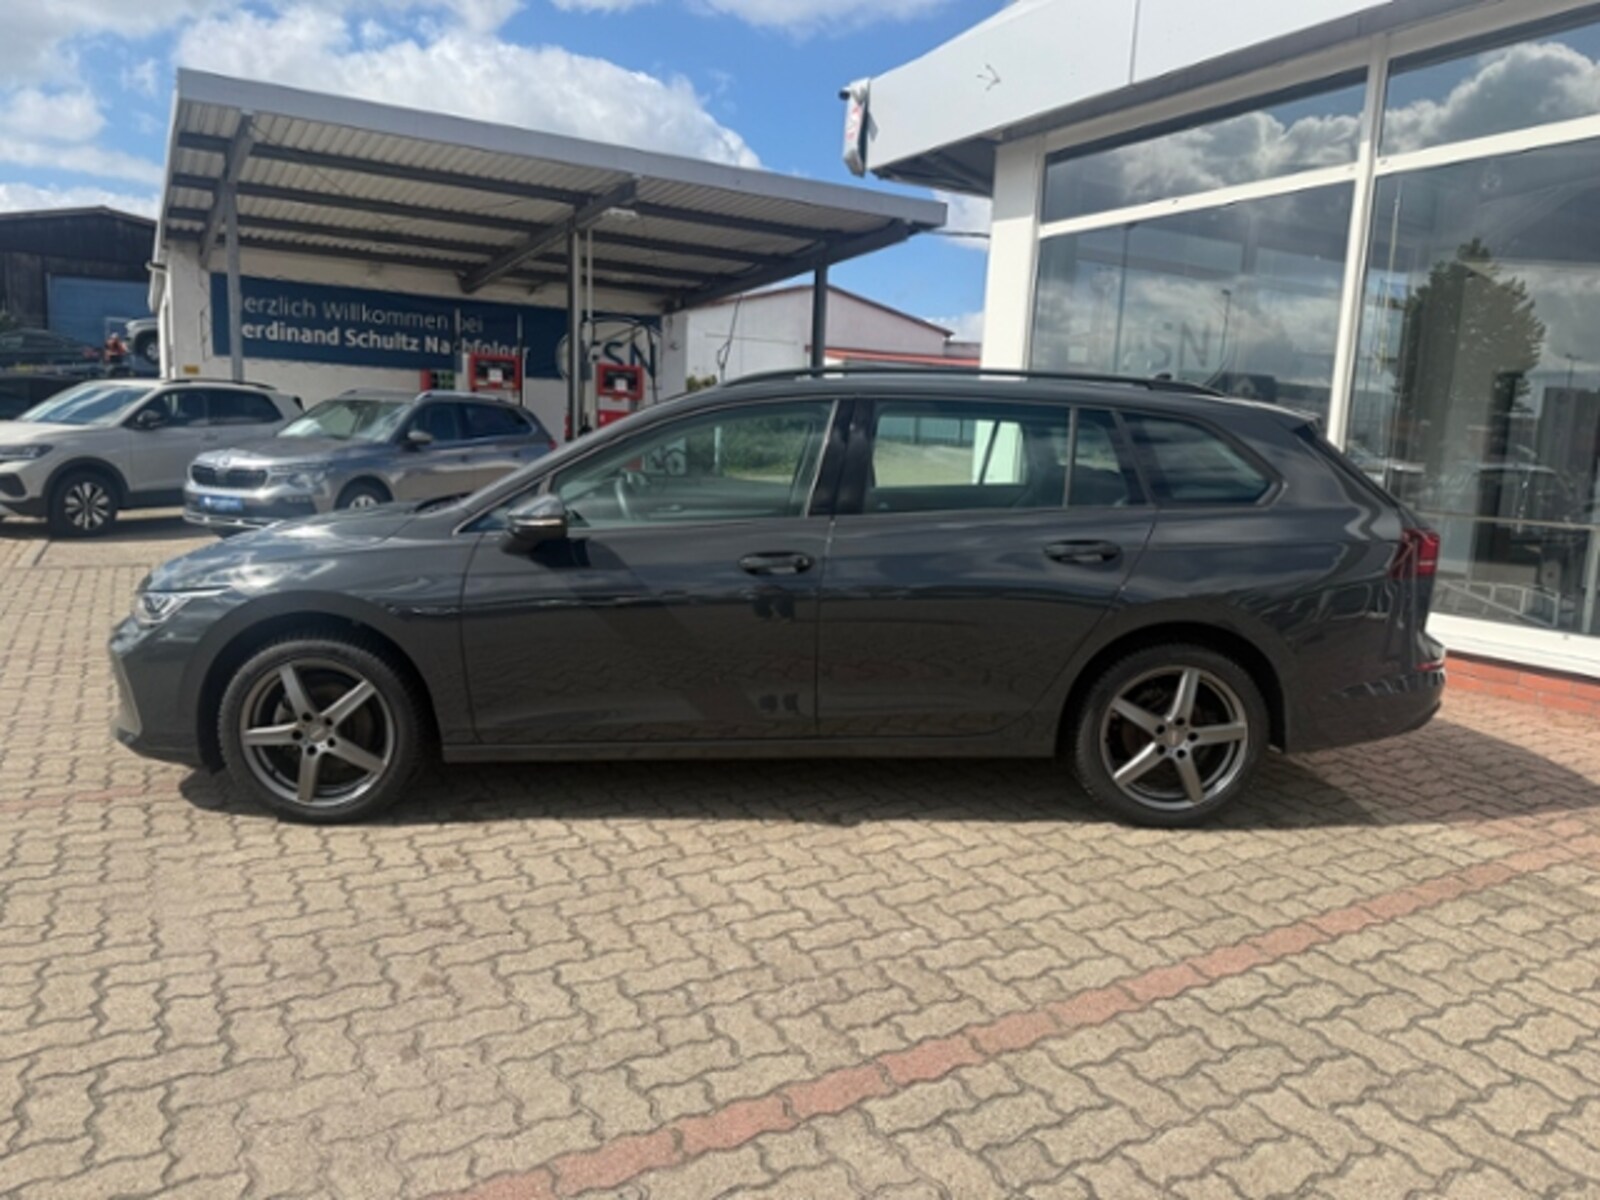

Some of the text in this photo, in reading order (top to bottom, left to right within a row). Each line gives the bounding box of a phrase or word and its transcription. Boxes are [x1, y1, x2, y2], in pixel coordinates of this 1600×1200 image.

[241, 296, 317, 318] erzlich
[322, 300, 449, 330] Willkommen
[240, 321, 340, 346] erdinand
[345, 329, 419, 351] Schultz
